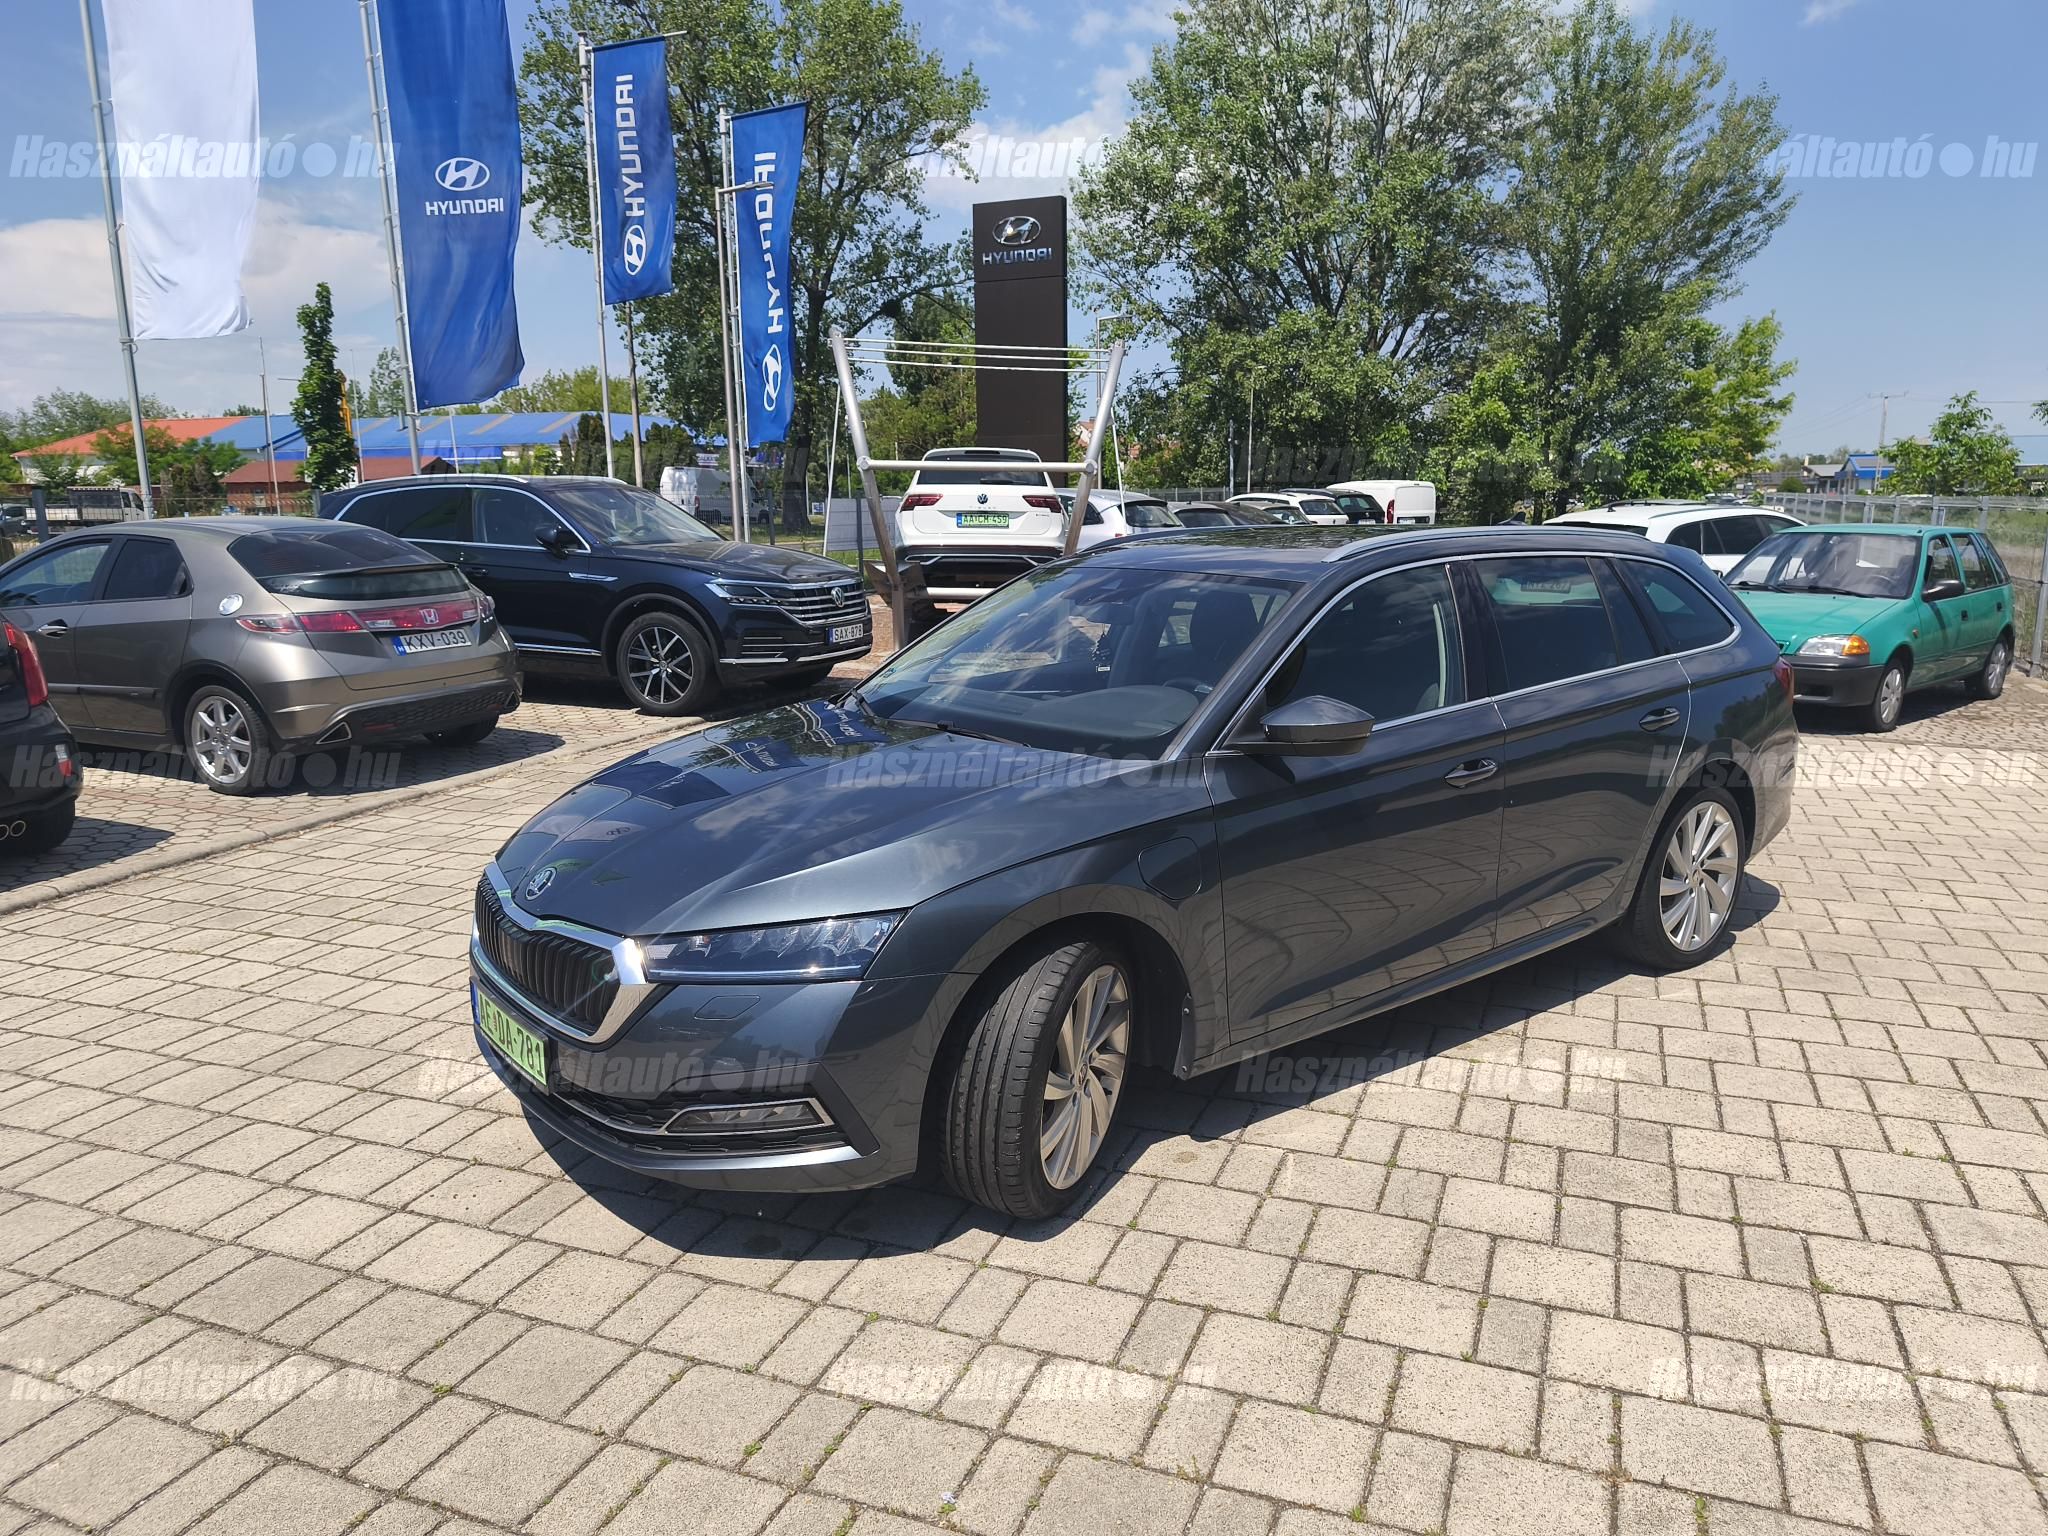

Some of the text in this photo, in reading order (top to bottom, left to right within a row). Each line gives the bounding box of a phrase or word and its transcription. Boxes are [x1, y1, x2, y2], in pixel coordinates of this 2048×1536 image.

[616, 74, 645, 217] HYUNDAI
[425, 197, 504, 216] HYUNDAI
[754, 152, 784, 334] HYUNDAI
[982, 247, 1052, 265] HYUNDAI
[404, 630, 467, 651] KXV-039
